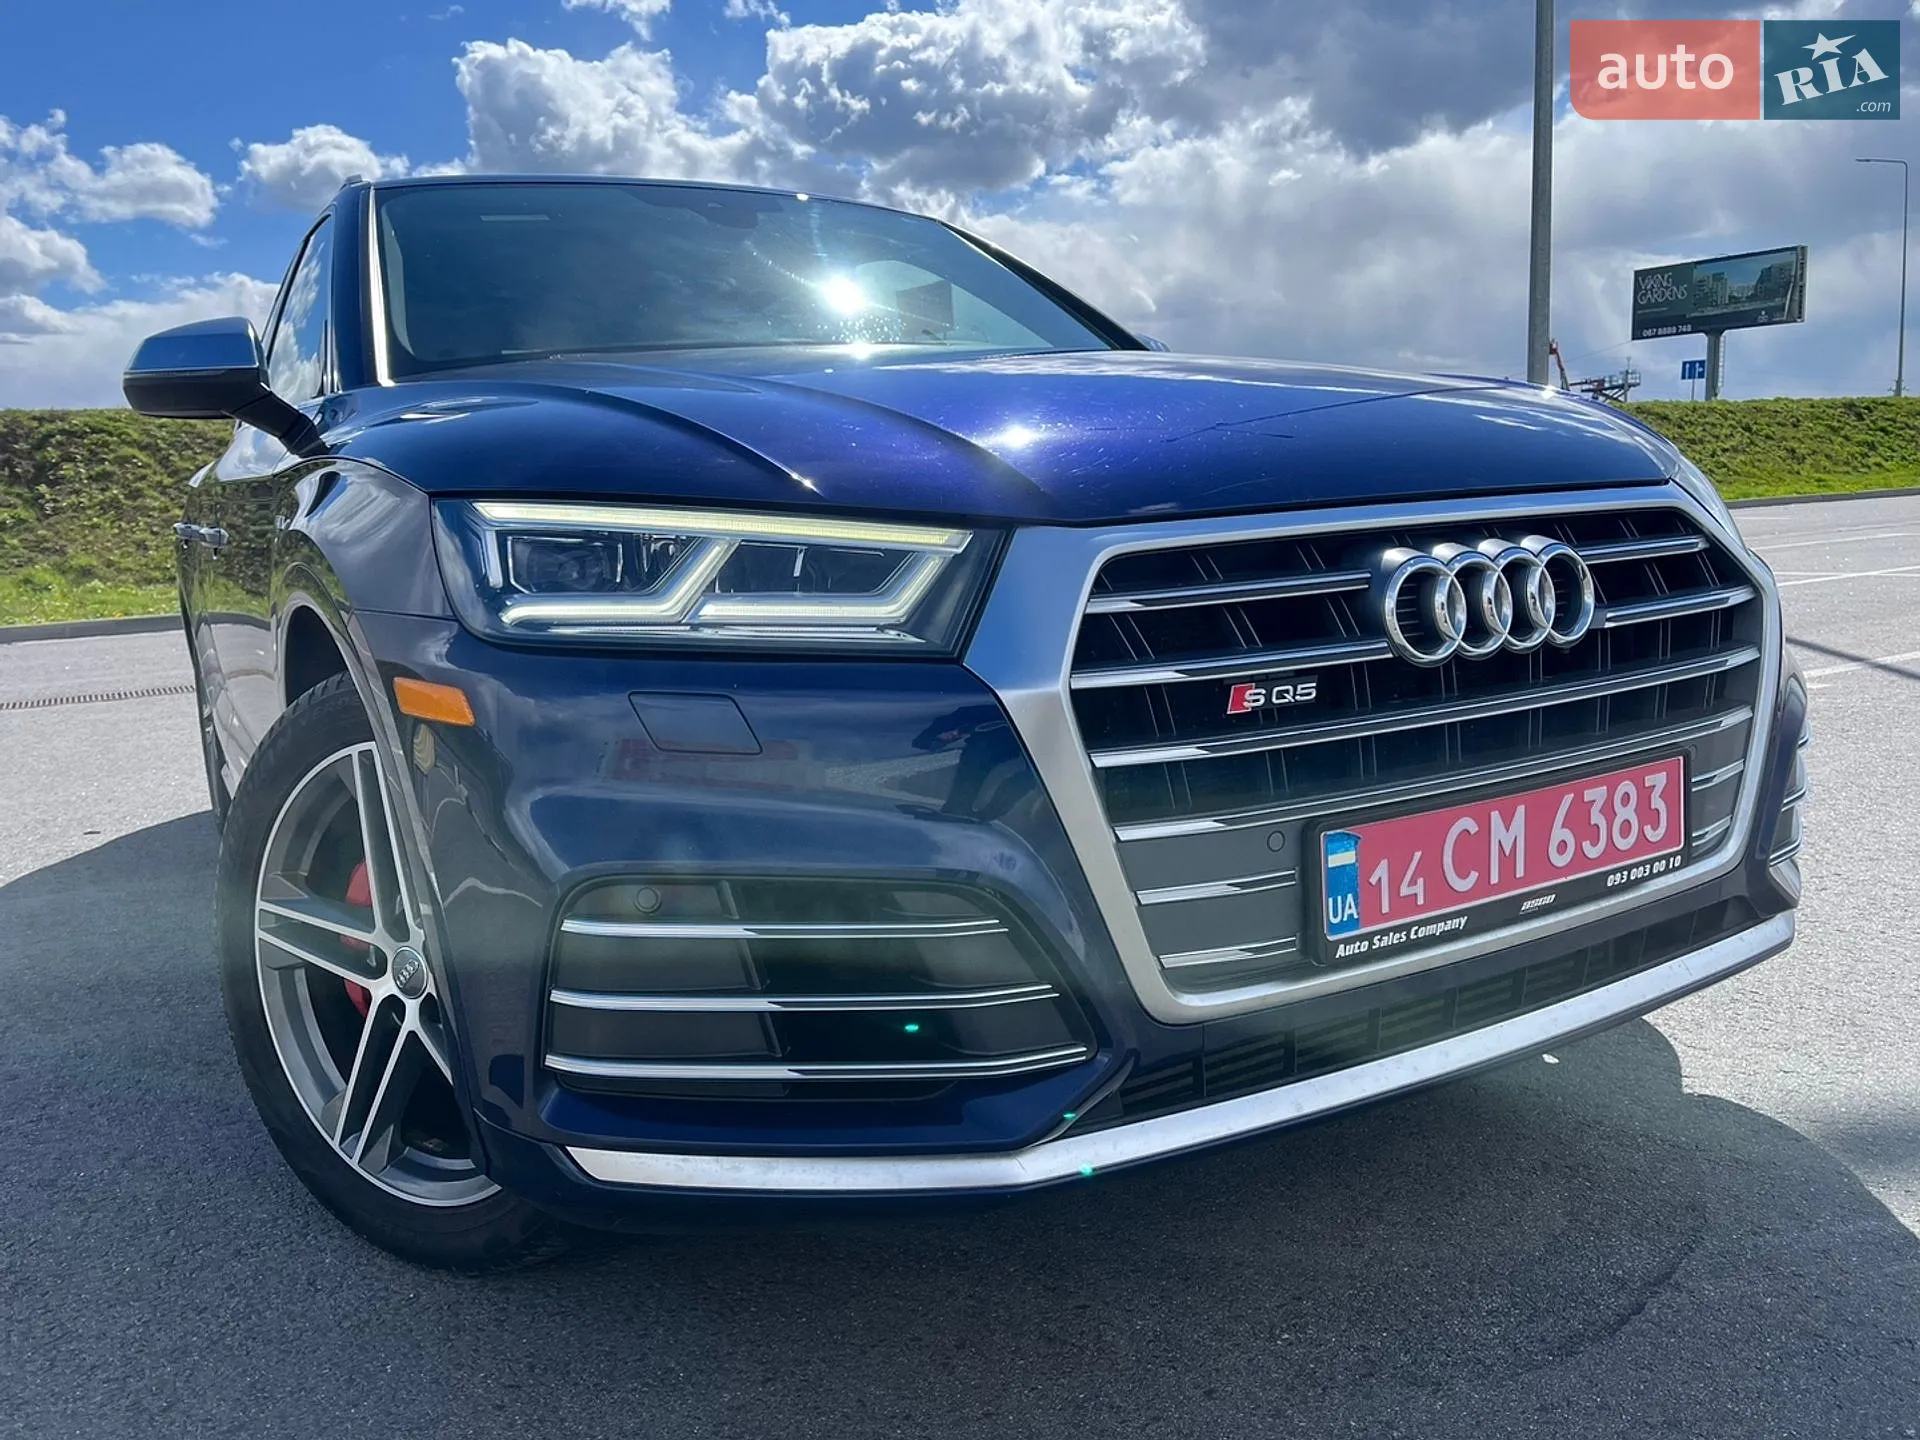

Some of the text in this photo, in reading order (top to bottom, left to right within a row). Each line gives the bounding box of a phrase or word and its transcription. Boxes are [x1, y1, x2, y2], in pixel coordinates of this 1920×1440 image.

[1368, 771, 1668, 914] 14 CM 6383
[1606, 855, 1682, 887] 093 003 00 10
[1328, 893, 1359, 924] UA
[1336, 916, 1468, 958] Auto Sales Company
